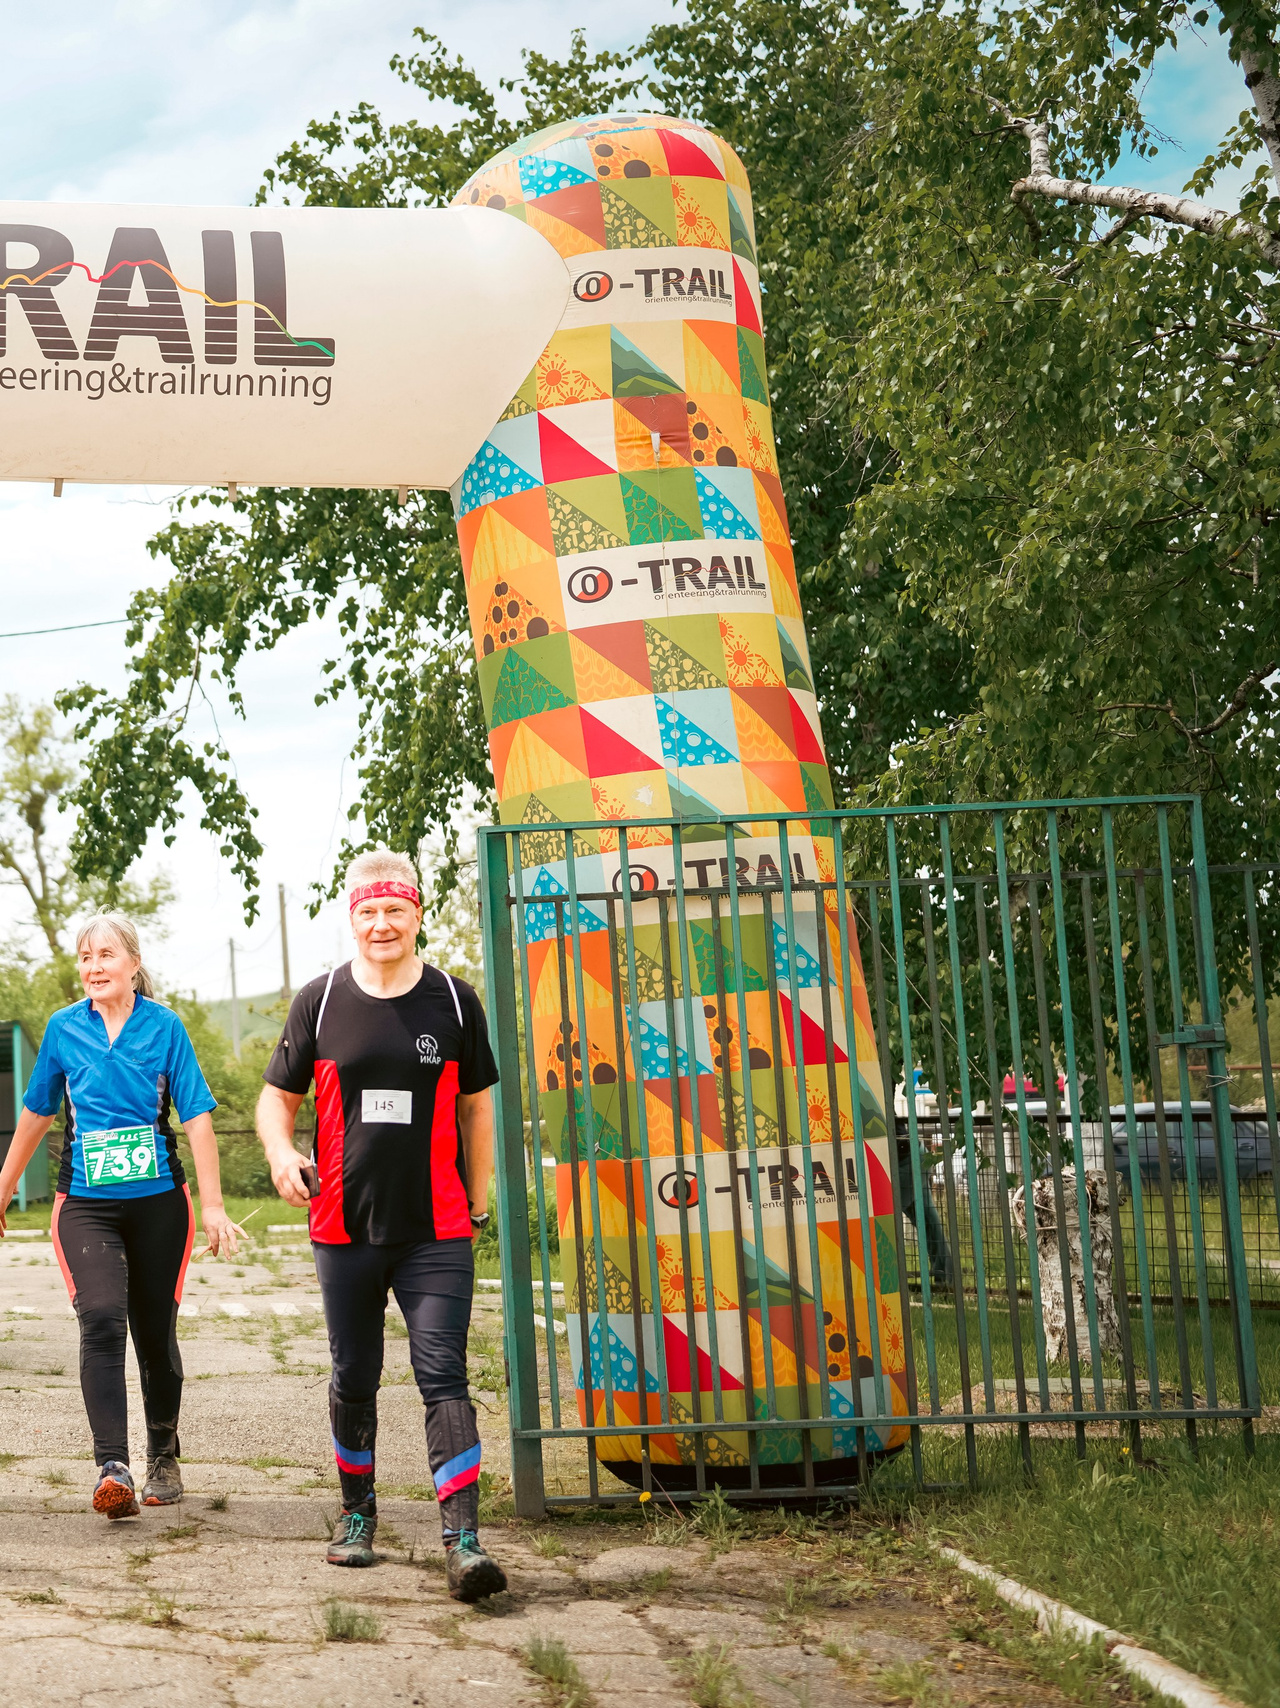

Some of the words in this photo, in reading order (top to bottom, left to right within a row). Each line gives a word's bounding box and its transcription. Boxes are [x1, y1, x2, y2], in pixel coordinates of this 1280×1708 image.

[644, 295, 733, 307] orienteering&trailrunning
[654, 587, 767, 600] orenteering&trailrunning
[420, 1055, 441, 1065] ИКАР
[374, 1100, 394, 1111] 145
[88, 1146, 152, 1180] 739
